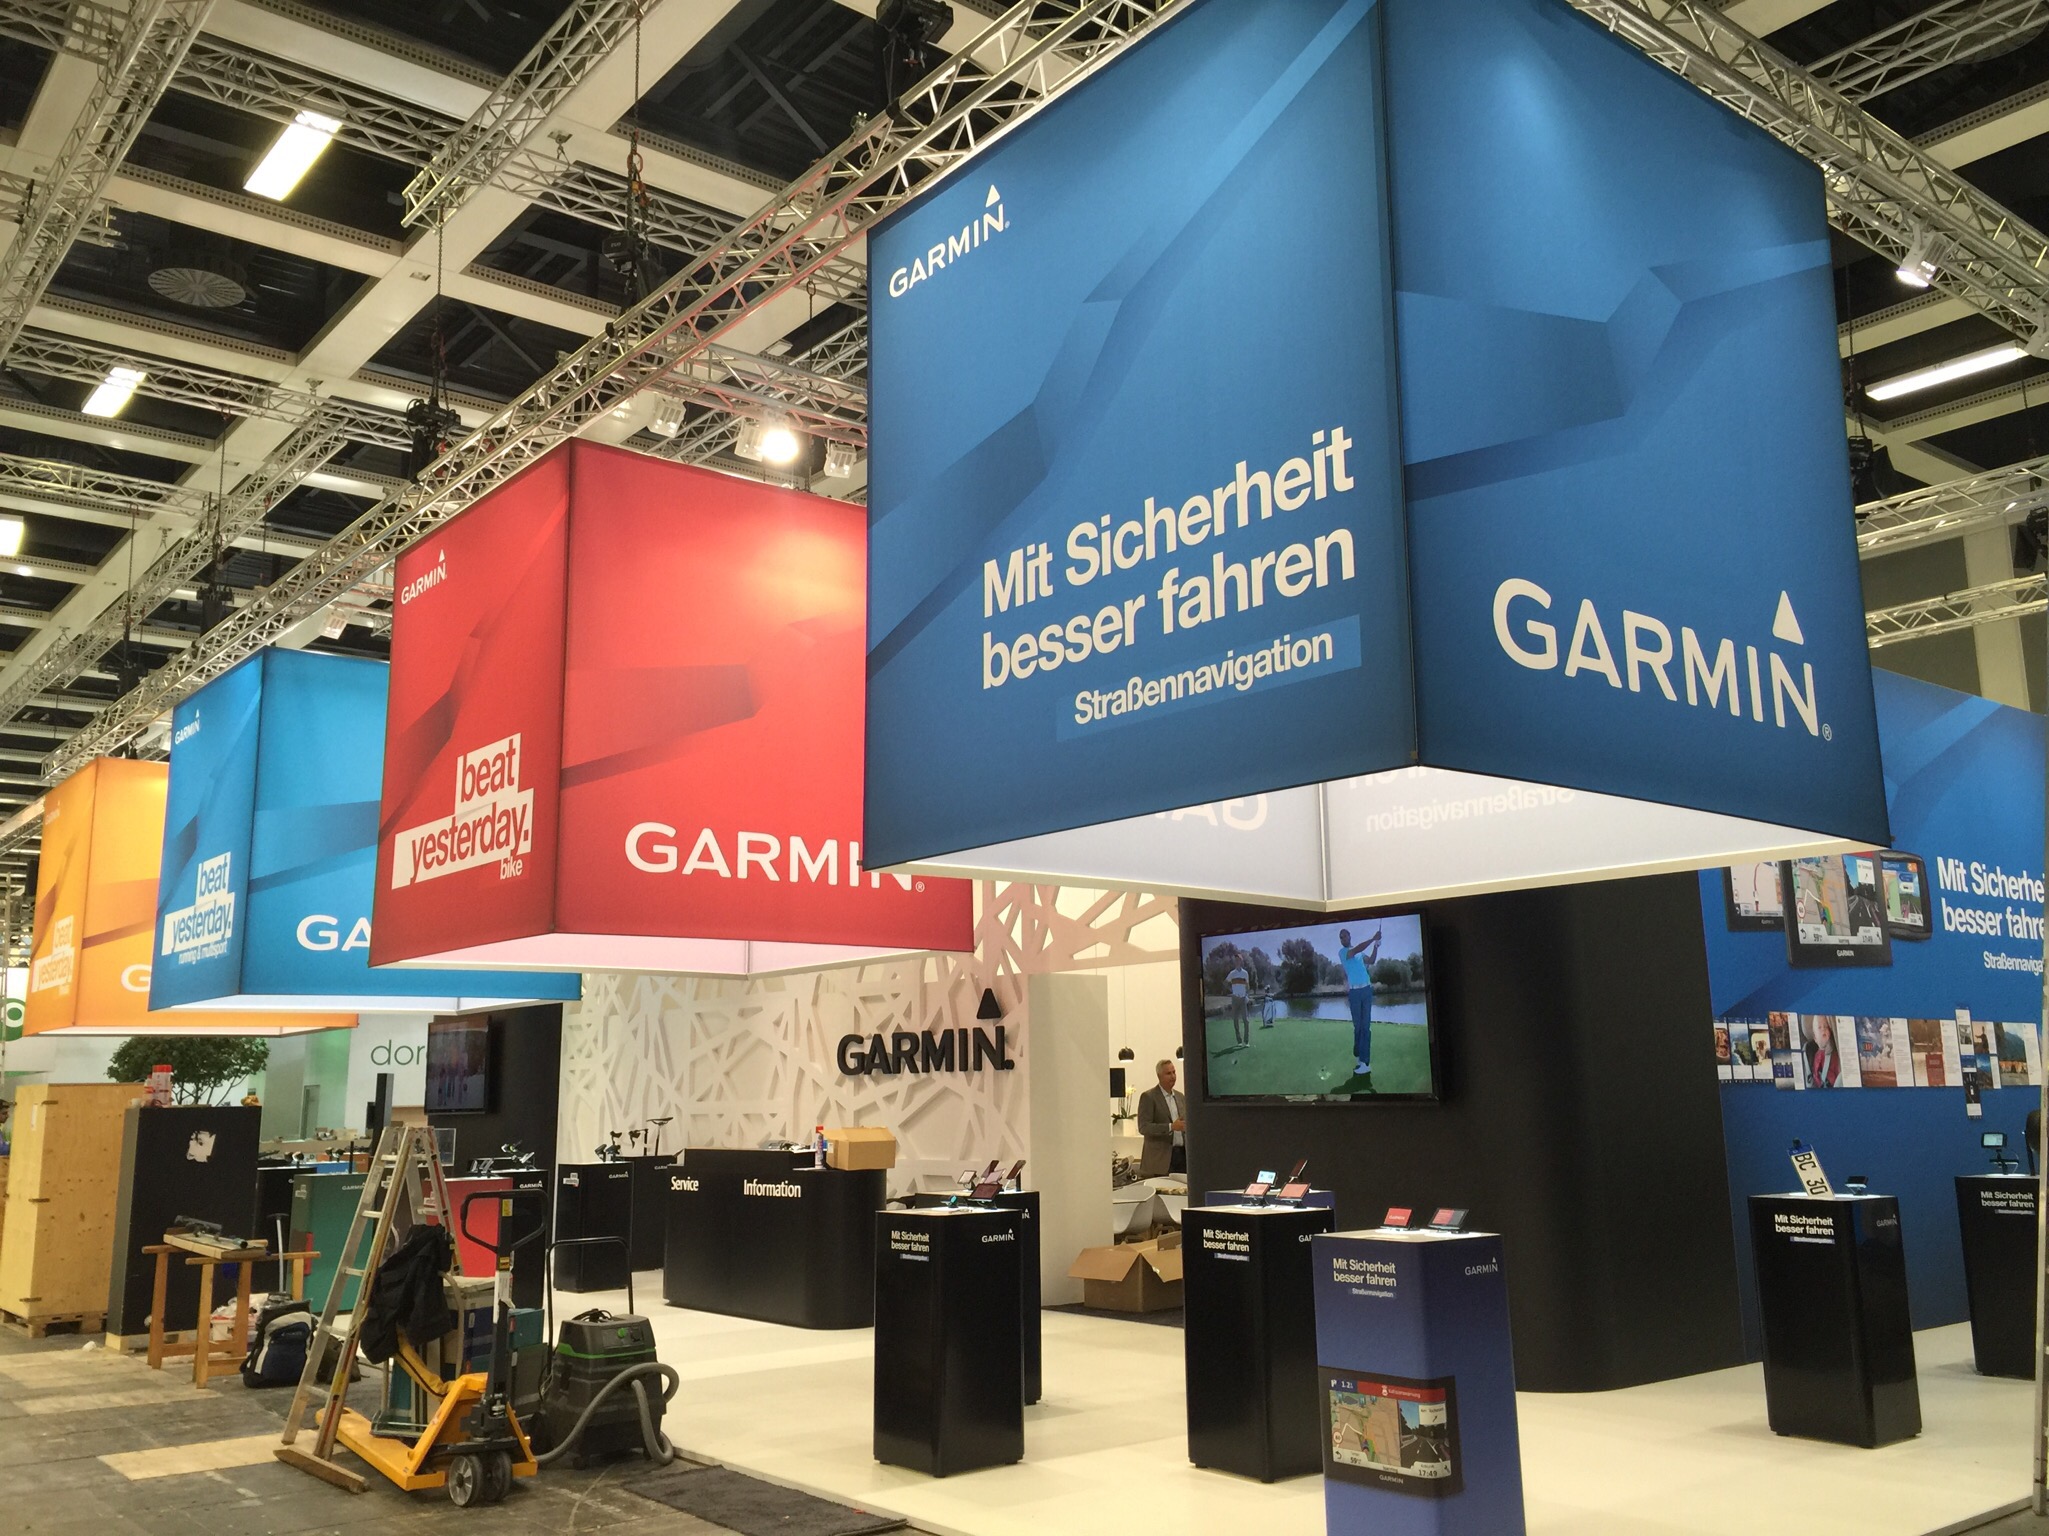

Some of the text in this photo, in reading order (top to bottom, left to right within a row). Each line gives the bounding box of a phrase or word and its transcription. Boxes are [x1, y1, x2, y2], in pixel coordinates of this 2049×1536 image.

[888, 203, 1005, 299] GARMIN
[982, 426, 1355, 619] Mit Sicherheit
[400, 561, 448, 606] GARMIN
[981, 528, 1356, 690] besser fahren
[1492, 577, 1819, 737] GARMIN
[1074, 632, 1334, 725] Straßennavigation
[460, 738, 517, 804] beat
[410, 802, 530, 883] yesterday.
[499, 855, 523, 881] bike
[200, 855, 228, 898] beat
[1936, 856, 2045, 904] Mit Sicherhe
[1941, 897, 2003, 937] besser
[171, 902, 232, 951] yesterday.
[670, 1176, 700, 1192] Service
[743, 1179, 802, 1198] Information
[1980, 1190, 2034, 1200] Mit Sicherheit
[1981, 1199, 2034, 1208] besser fahren
[1774, 1213, 1834, 1226] Mit Sicherheit
[1876, 1218, 1898, 1227] GARMIN
[891, 1230, 930, 1243] Mit Sicherheit
[981, 1232, 1015, 1243] GARMIN
[1203, 1229, 1249, 1242] Mit Sicherheit
[1775, 1223, 1835, 1236] besser fahren
[891, 1241, 930, 1253] besser fahren
[1203, 1239, 1249, 1252] besser fahren
[1332, 1257, 1396, 1274] Mit Sicherheit
[1464, 1263, 1499, 1276] GARMIN
[1333, 1271, 1396, 1287] besser fahren
[1352, 1287, 1394, 1298] Straßennavigation
[1379, 1474, 1404, 1484] GARMIN
[1418, 1469, 1438, 1477] 17:49
